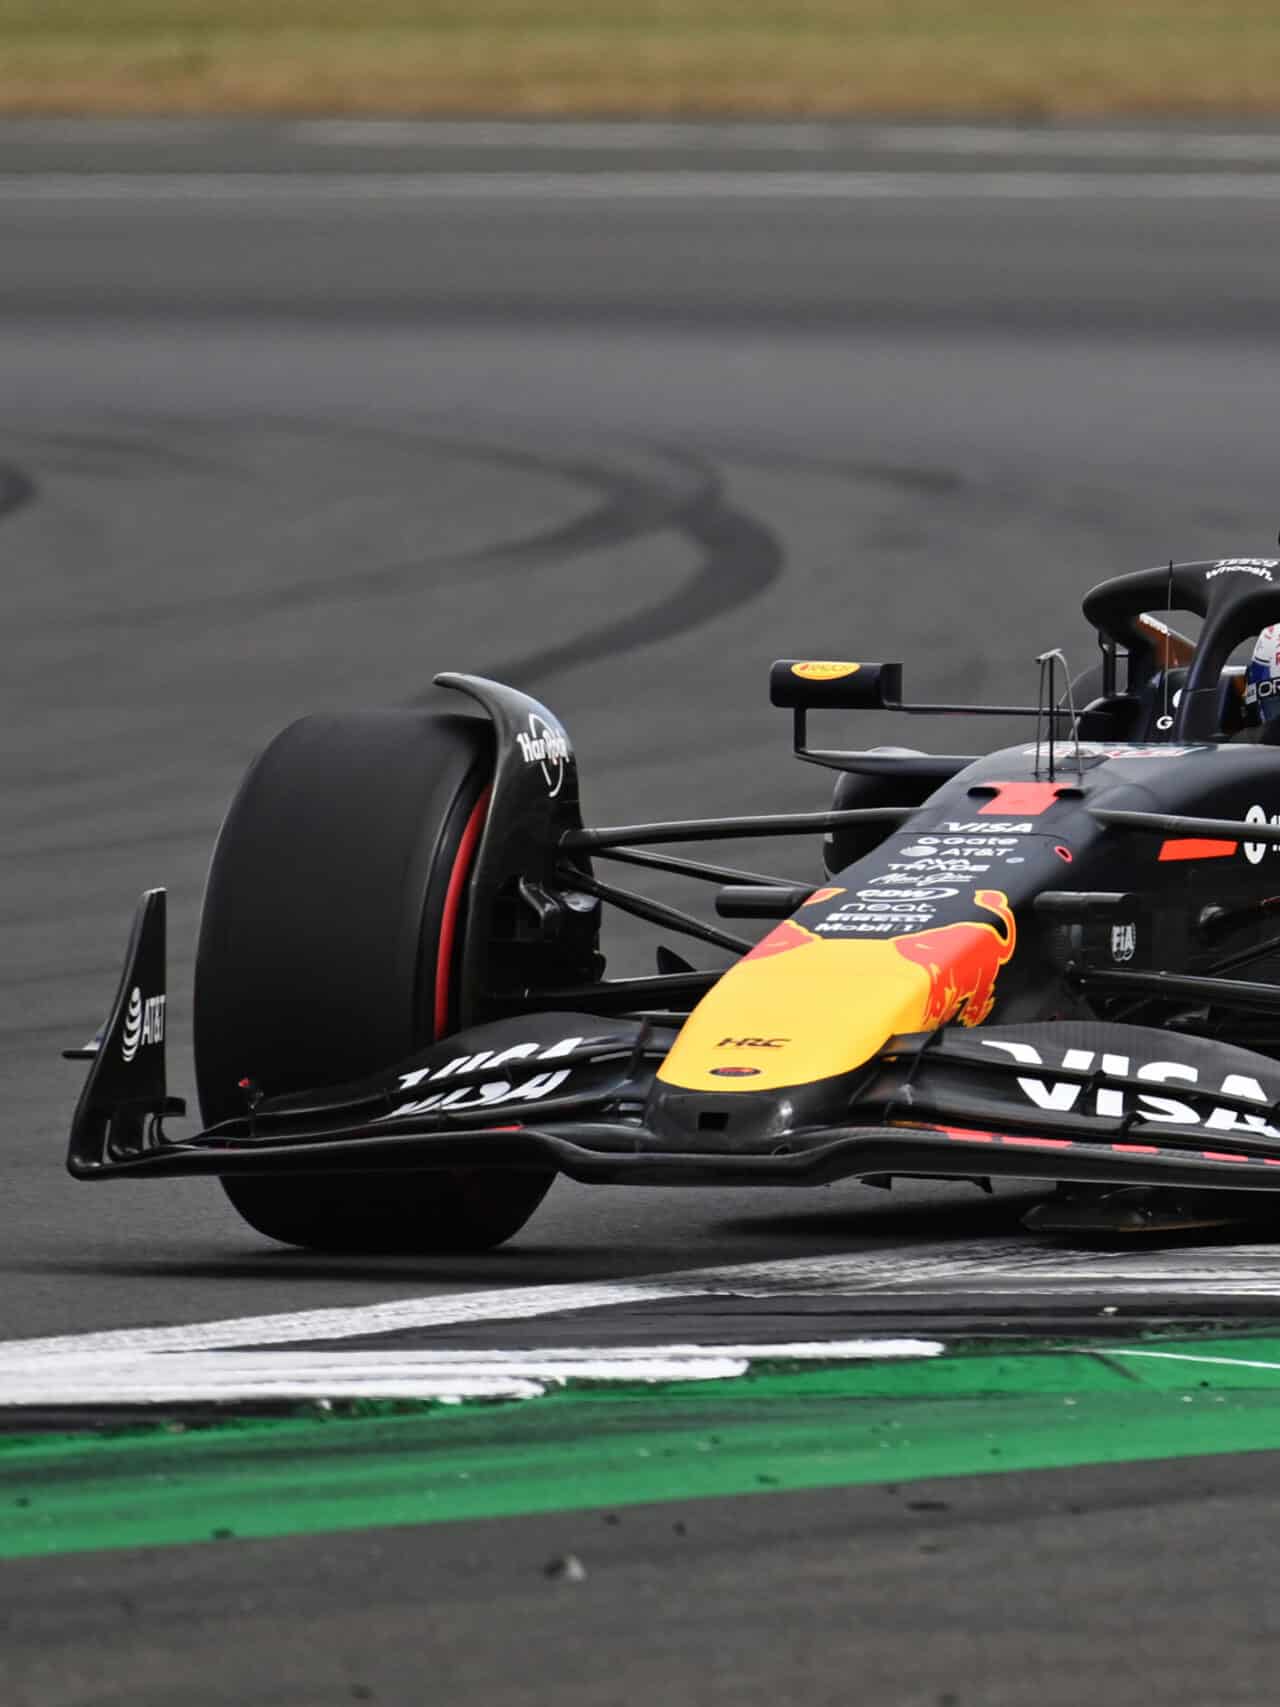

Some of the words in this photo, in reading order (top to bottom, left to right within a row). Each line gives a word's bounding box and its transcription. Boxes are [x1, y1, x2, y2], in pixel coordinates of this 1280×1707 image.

[943, 822, 1033, 833] VISA
[939, 847, 1015, 857] AT&T
[814, 922, 894, 932] Mobil
[715, 1037, 793, 1048] HRC
